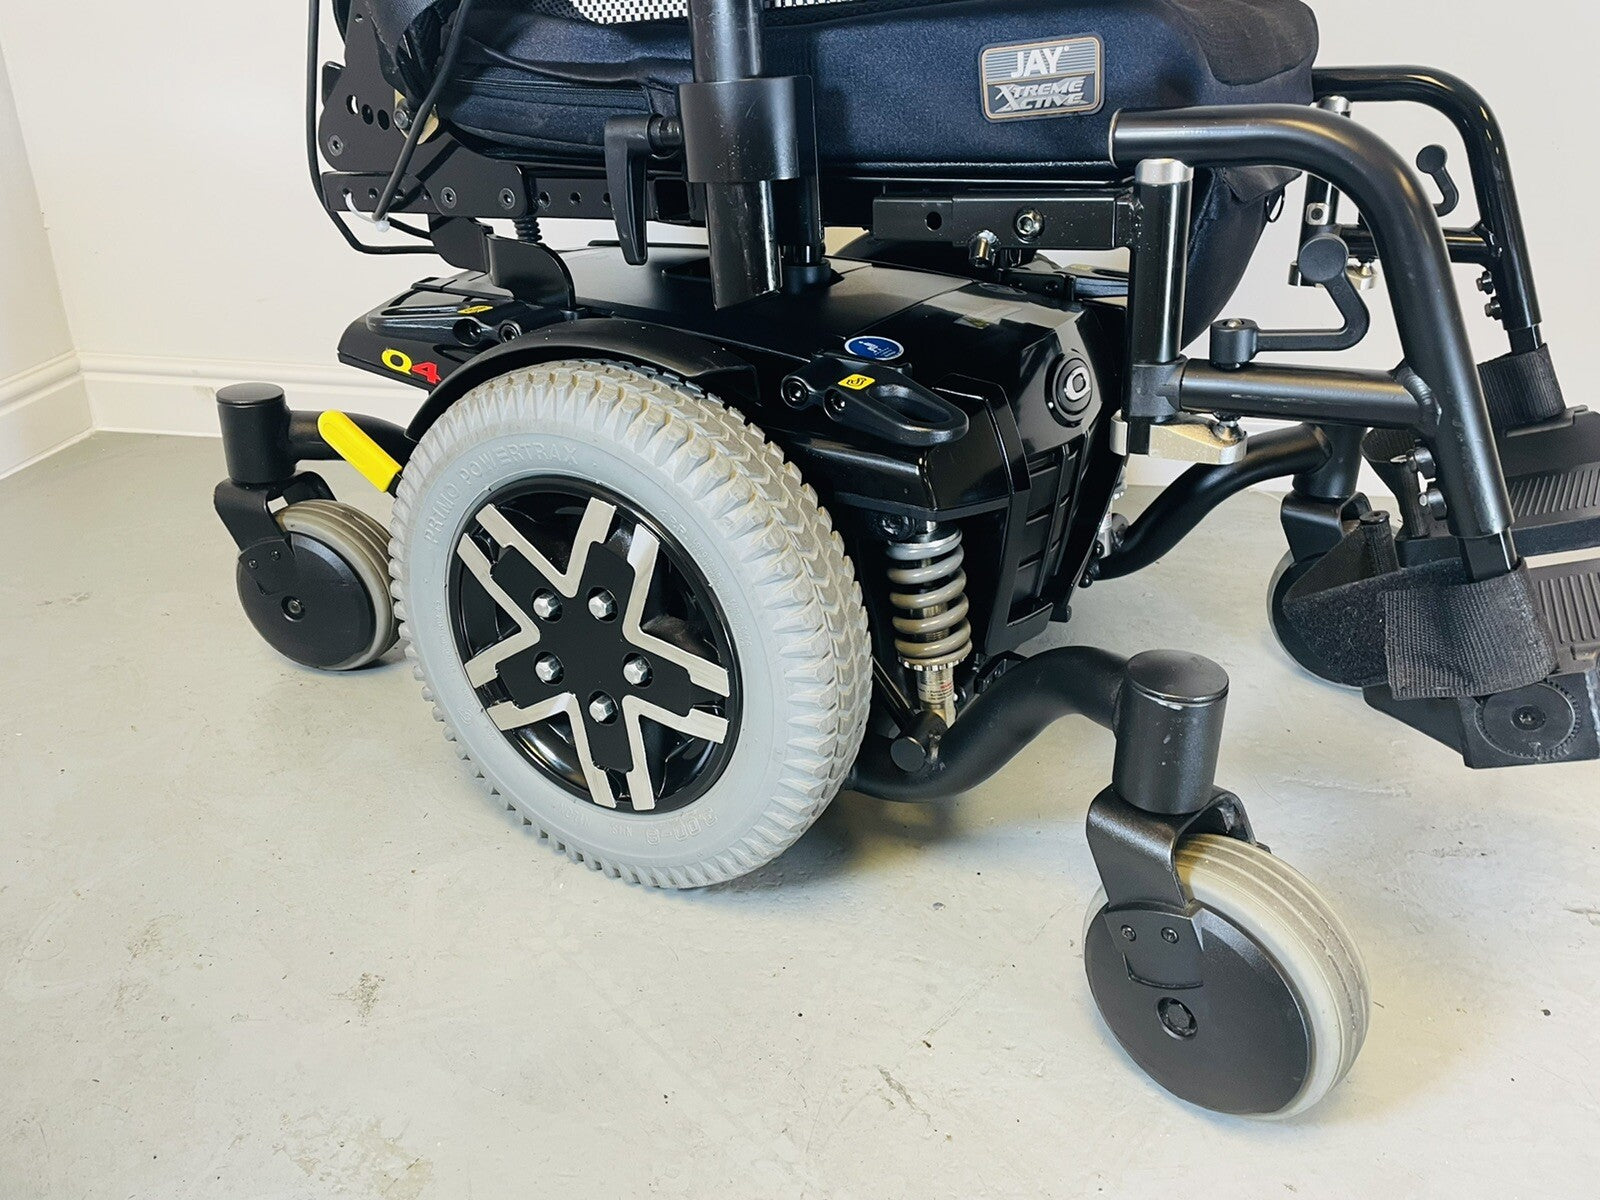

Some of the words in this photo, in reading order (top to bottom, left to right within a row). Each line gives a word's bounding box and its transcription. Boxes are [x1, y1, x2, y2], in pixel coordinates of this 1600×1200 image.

[1010, 46, 1065, 78] JAY
[994, 76, 1087, 100] XTREME
[381, 348, 442, 384] Q4
[423, 481, 458, 545] PRIMO
[458, 442, 579, 486] POWERTRAX
